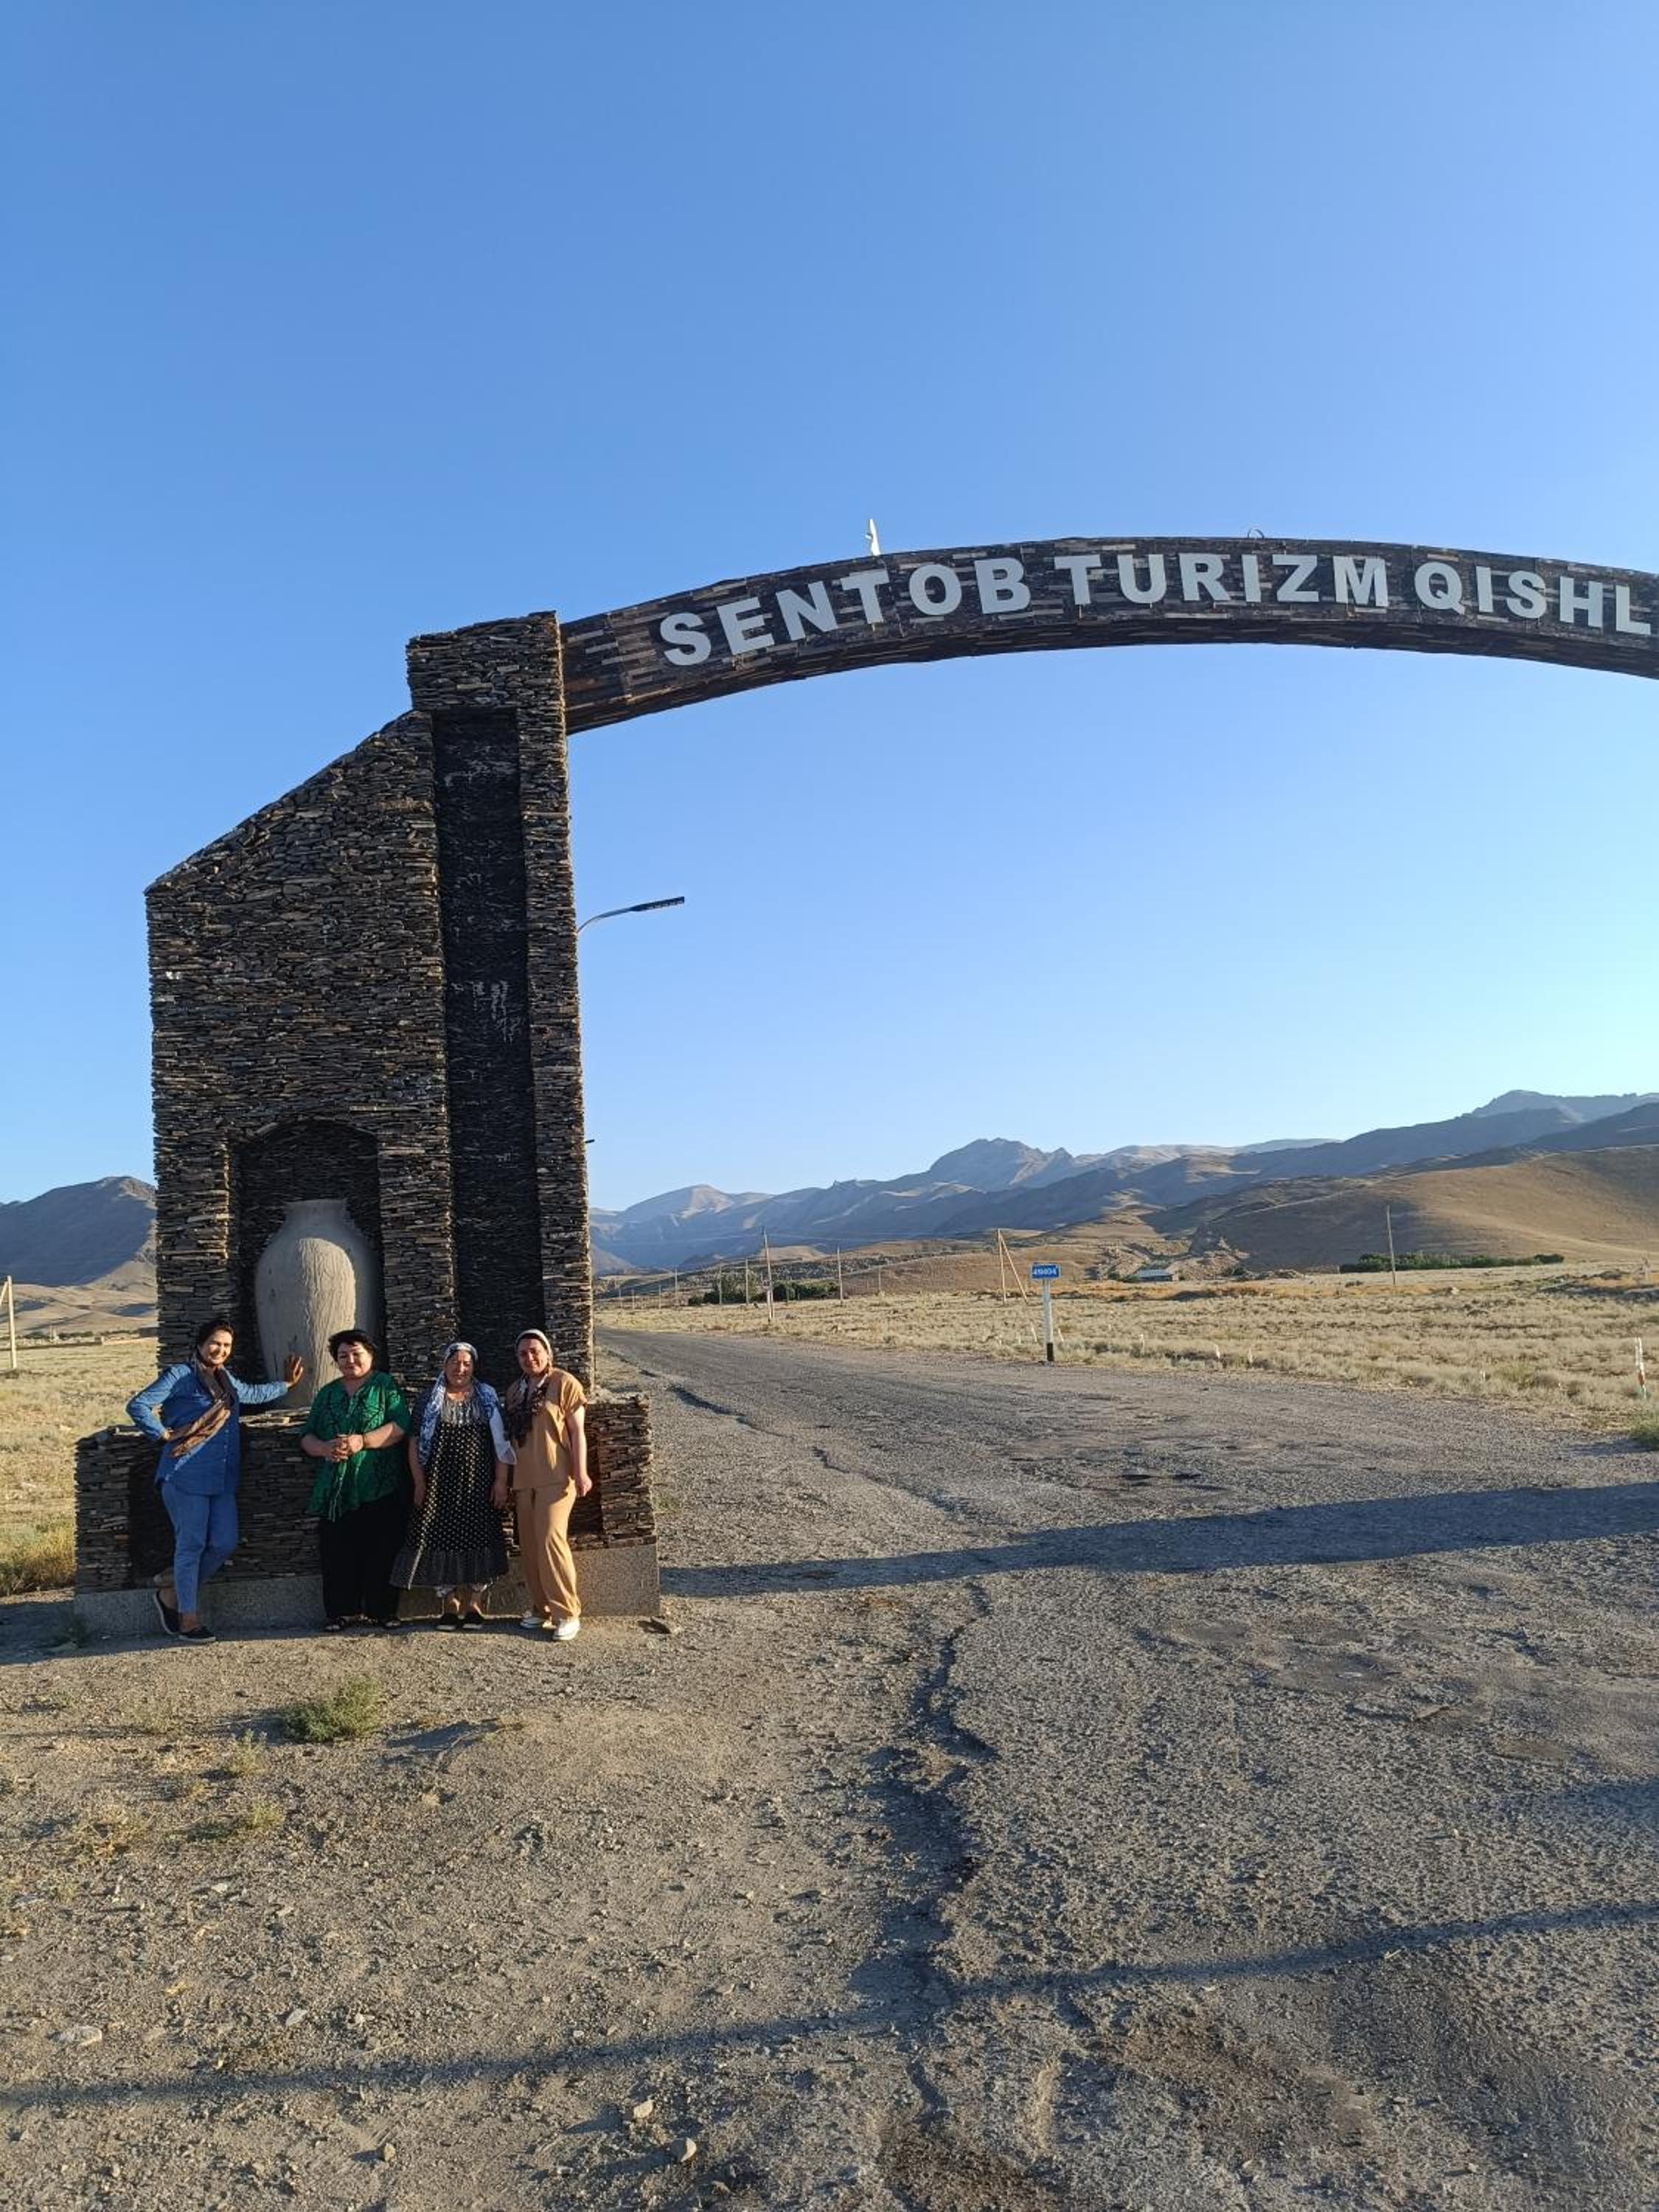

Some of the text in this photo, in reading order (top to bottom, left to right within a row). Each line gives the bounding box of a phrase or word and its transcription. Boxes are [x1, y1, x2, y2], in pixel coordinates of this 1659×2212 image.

[660, 553, 1652, 666] SENTOB TURIZM QISHL
